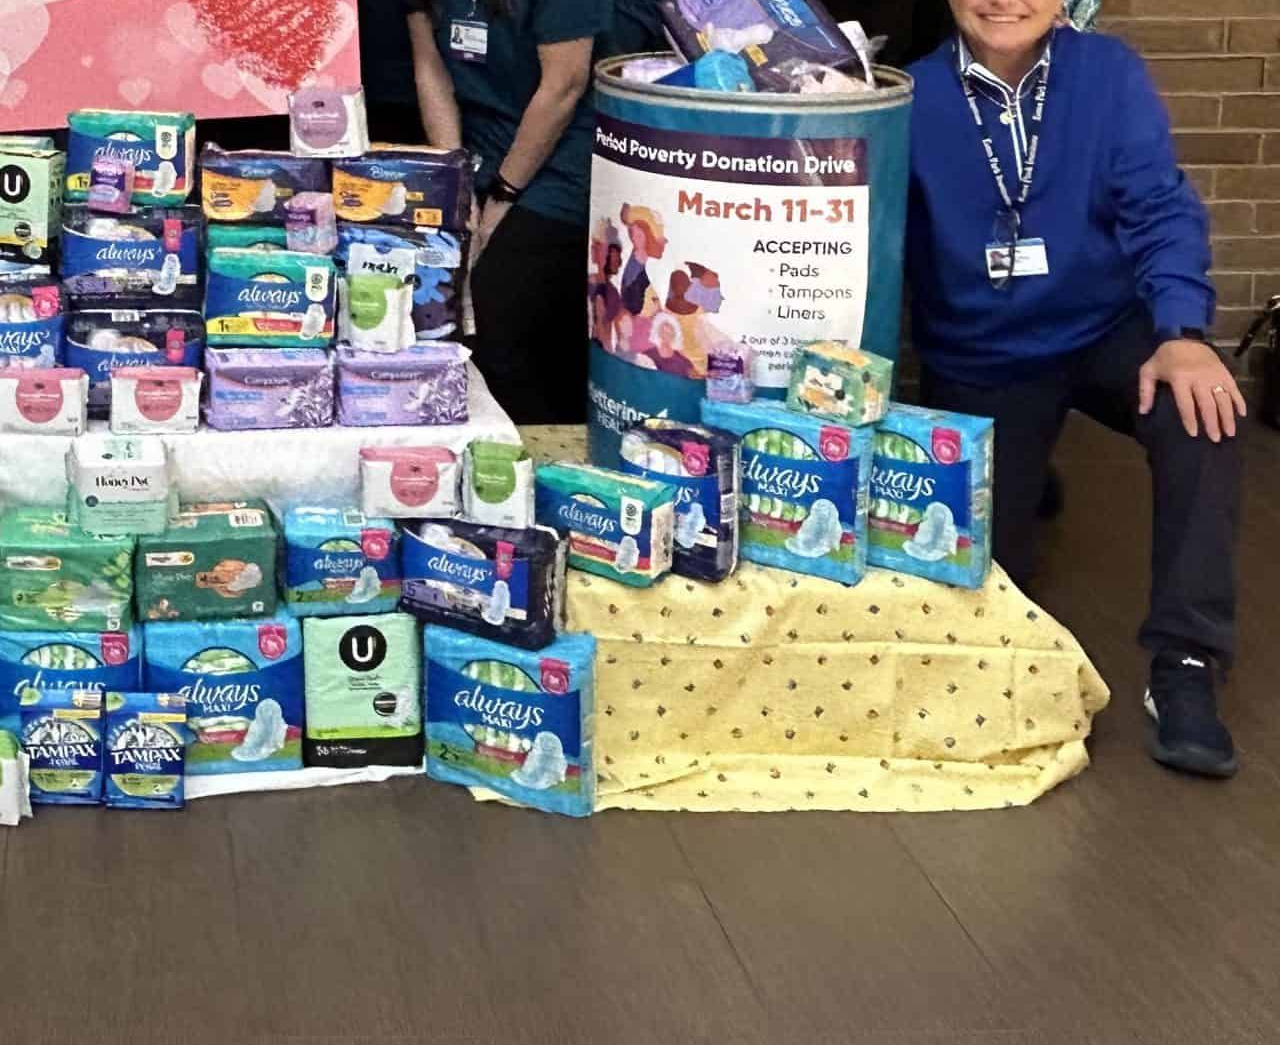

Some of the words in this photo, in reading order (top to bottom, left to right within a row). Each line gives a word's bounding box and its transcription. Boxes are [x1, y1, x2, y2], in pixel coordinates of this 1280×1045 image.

[95, 140, 152, 164] always
[596, 127, 627, 154] Period
[630, 139, 696, 169] Poverty
[702, 151, 799, 174] Donation
[804, 155, 857, 175] Drive
[4, 173, 22, 196] U
[677, 190, 773, 223] March
[782, 198, 856, 223] 11-31
[96, 243, 156, 262] always
[753, 240, 853, 255] ACCEPTING
[779, 263, 820, 278] Pads
[238, 285, 302, 306] always
[778, 285, 853, 300] Tampons
[777, 305, 826, 321] Liners
[558, 502, 617, 535] always
[314, 556, 363, 572] always
[427, 554, 486, 583] always
[351, 636, 373, 662] U
[178, 678, 261, 711] always
[202, 704, 231, 713] MAXI
[454, 685, 545, 729] always
[28, 744, 97, 760] TAMPAX
[111, 748, 183, 765] TAMPAX
